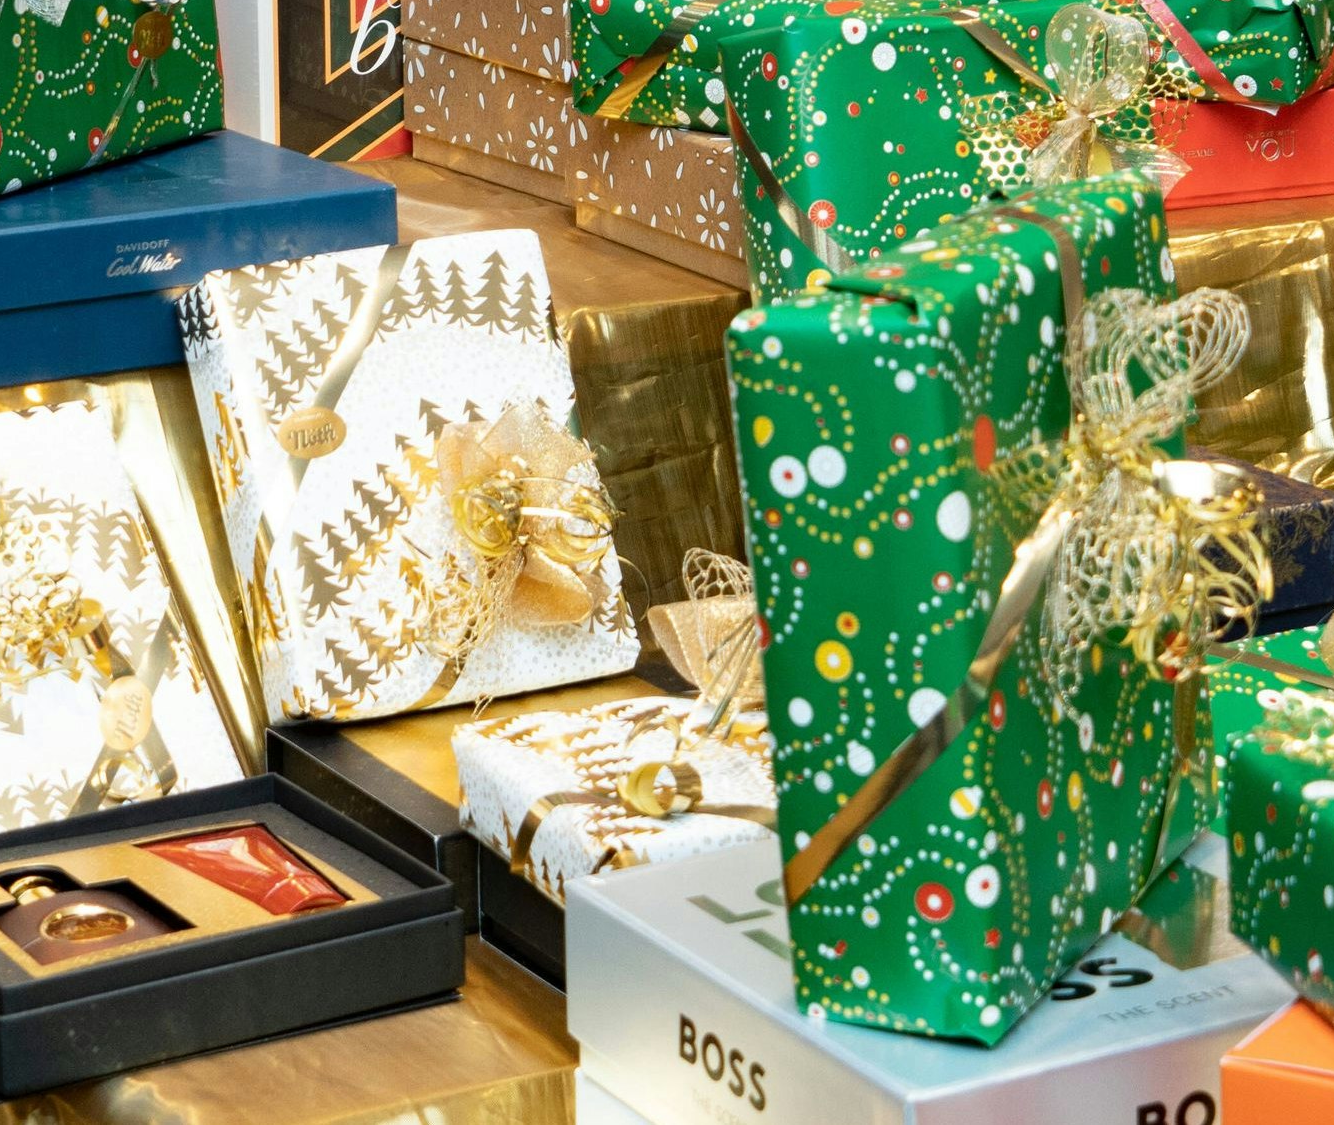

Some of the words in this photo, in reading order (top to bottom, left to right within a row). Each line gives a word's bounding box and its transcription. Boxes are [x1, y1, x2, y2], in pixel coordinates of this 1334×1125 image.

[1245, 137, 1295, 162] YOU
[116, 239, 170, 253] DAVIDOFF
[107, 255, 141, 278] Cool
[138, 252, 182, 274] Water
[1097, 1004, 1155, 1024] THE
[1155, 983, 1236, 1010] SCENT
[679, 1013, 767, 1112] BOSS
[1136, 1089, 1216, 1125] BO
